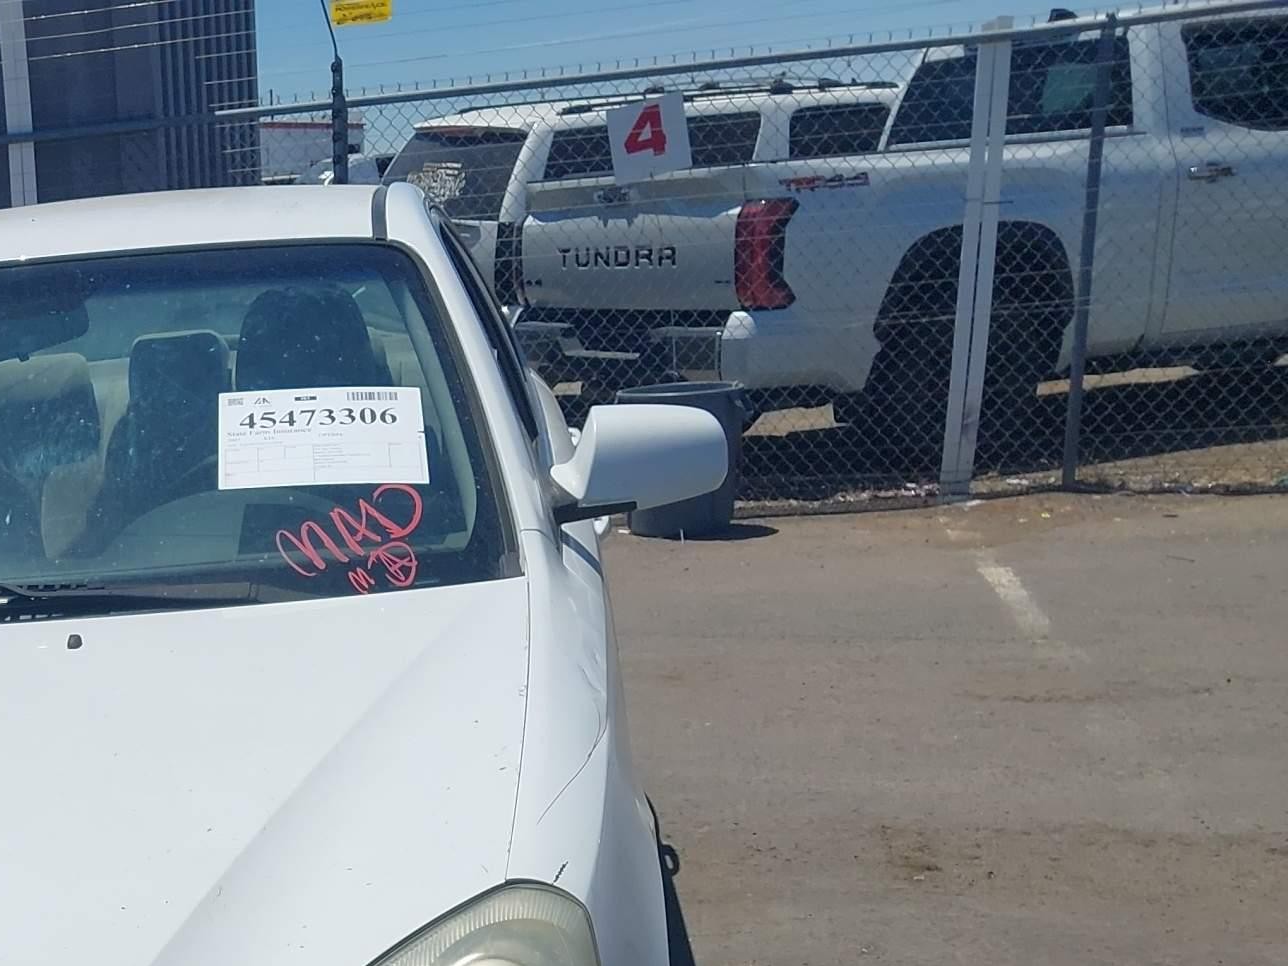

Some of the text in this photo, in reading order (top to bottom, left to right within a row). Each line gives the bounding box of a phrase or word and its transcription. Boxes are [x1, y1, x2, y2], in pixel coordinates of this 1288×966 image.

[623, 104, 668, 156] 4
[557, 245, 678, 269] TUNDRA
[239, 407, 398, 430] 45473306
